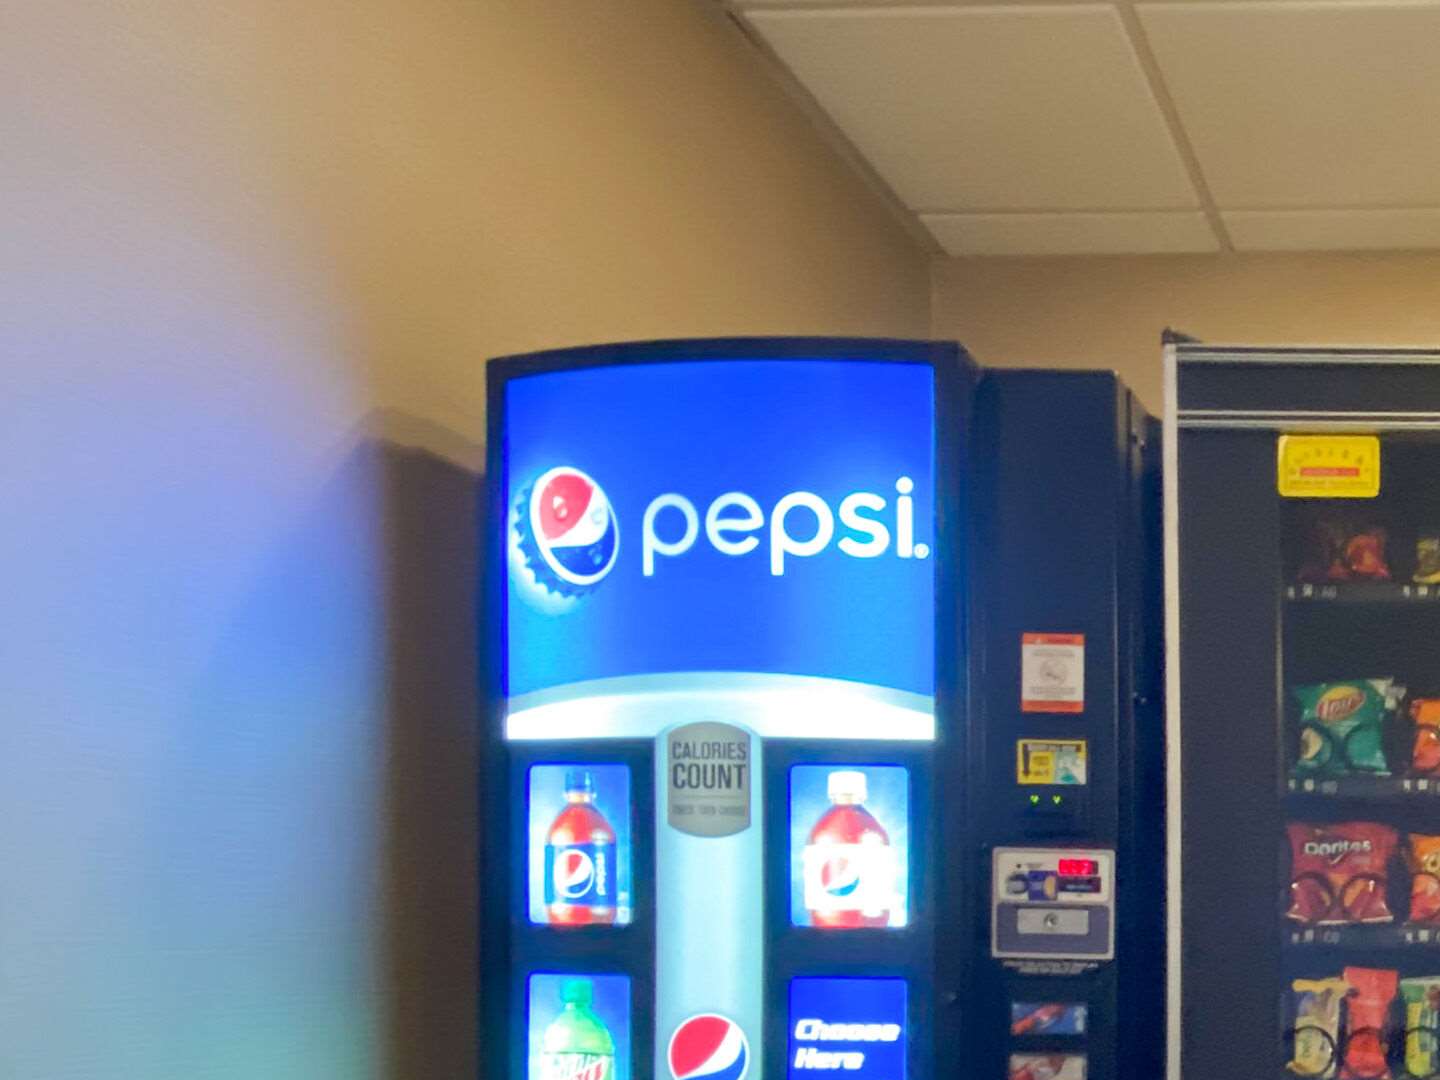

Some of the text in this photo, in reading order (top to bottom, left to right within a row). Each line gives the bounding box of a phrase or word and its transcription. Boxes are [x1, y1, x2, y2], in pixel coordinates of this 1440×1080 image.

[643, 476, 914, 577] pepsi
[671, 741, 747, 761] CALORIES
[671, 762, 747, 790] COUNT
[1304, 839, 1372, 857] Doritos
[795, 1019, 901, 1042] Choose
[794, 1048, 865, 1069] Here
